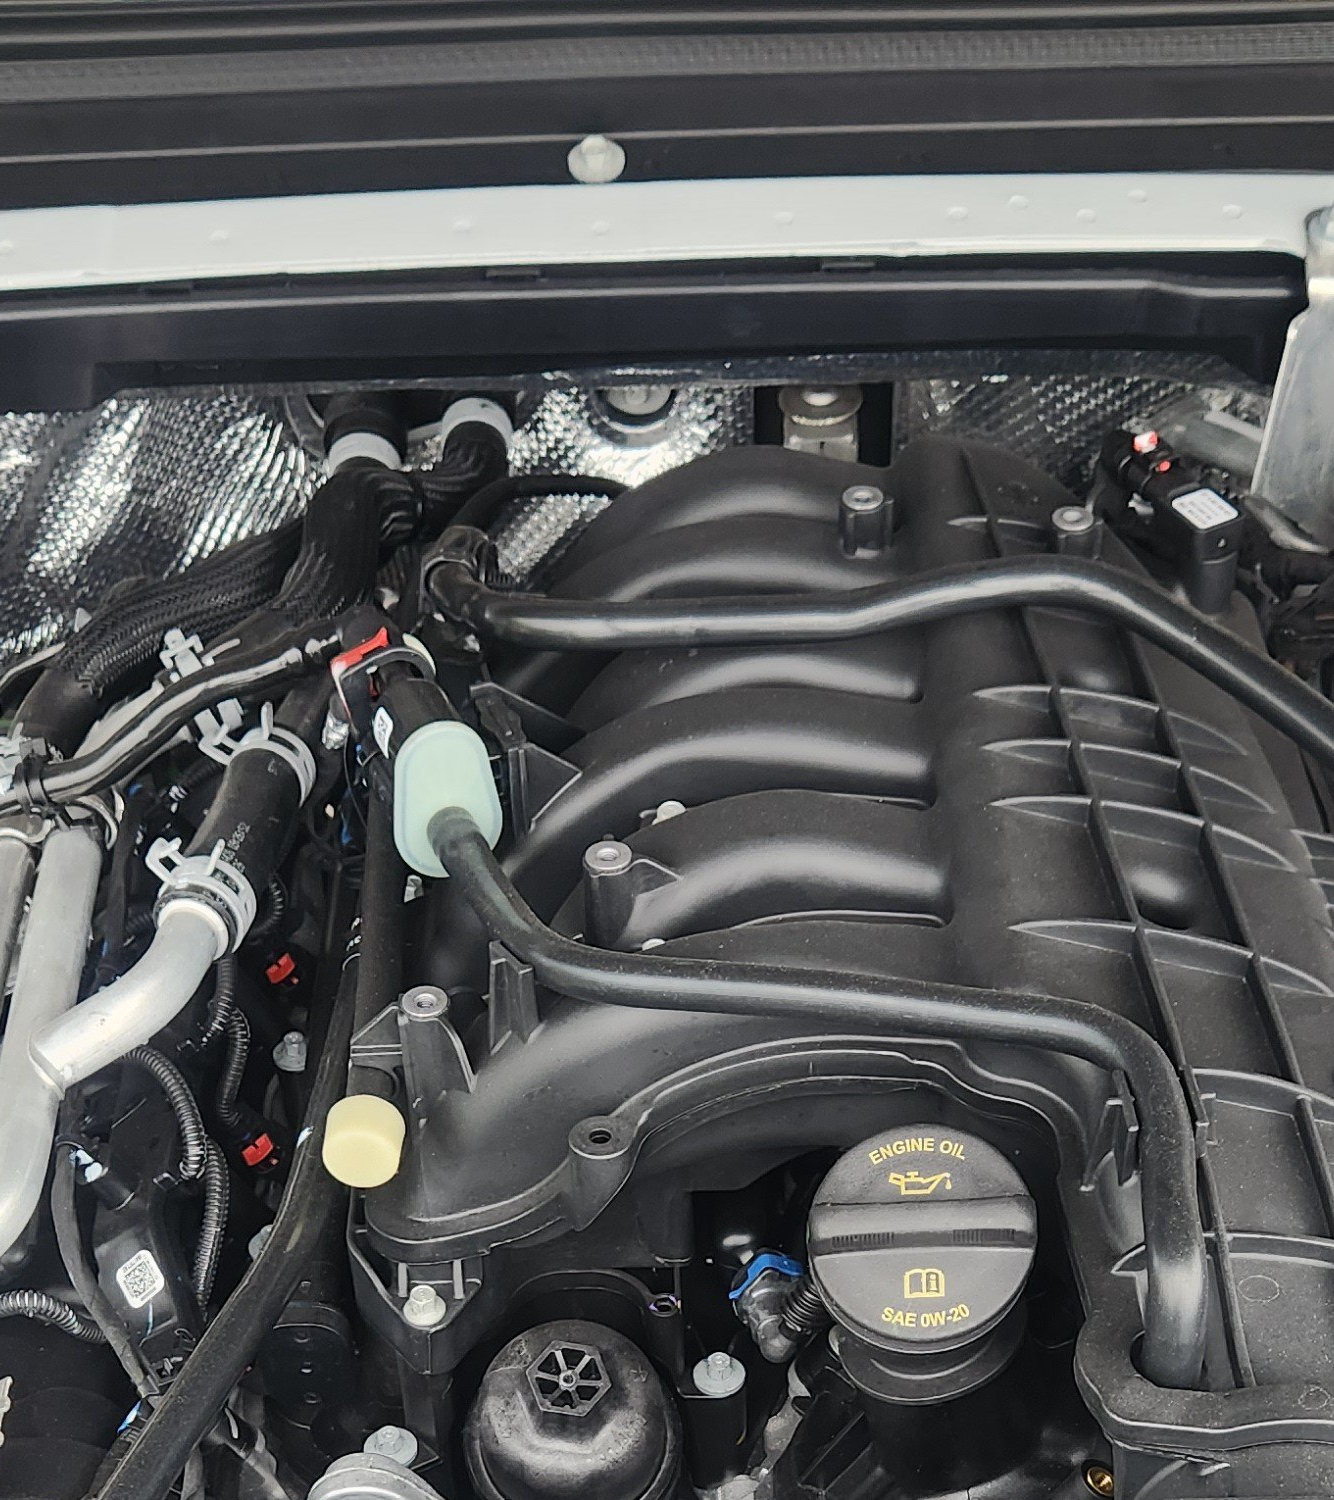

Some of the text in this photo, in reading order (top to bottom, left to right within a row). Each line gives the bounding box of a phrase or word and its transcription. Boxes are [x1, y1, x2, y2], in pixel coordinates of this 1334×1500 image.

[868, 1137, 966, 1166] ENGINE OIL
[881, 1302, 970, 1328] SAE 0W-20
